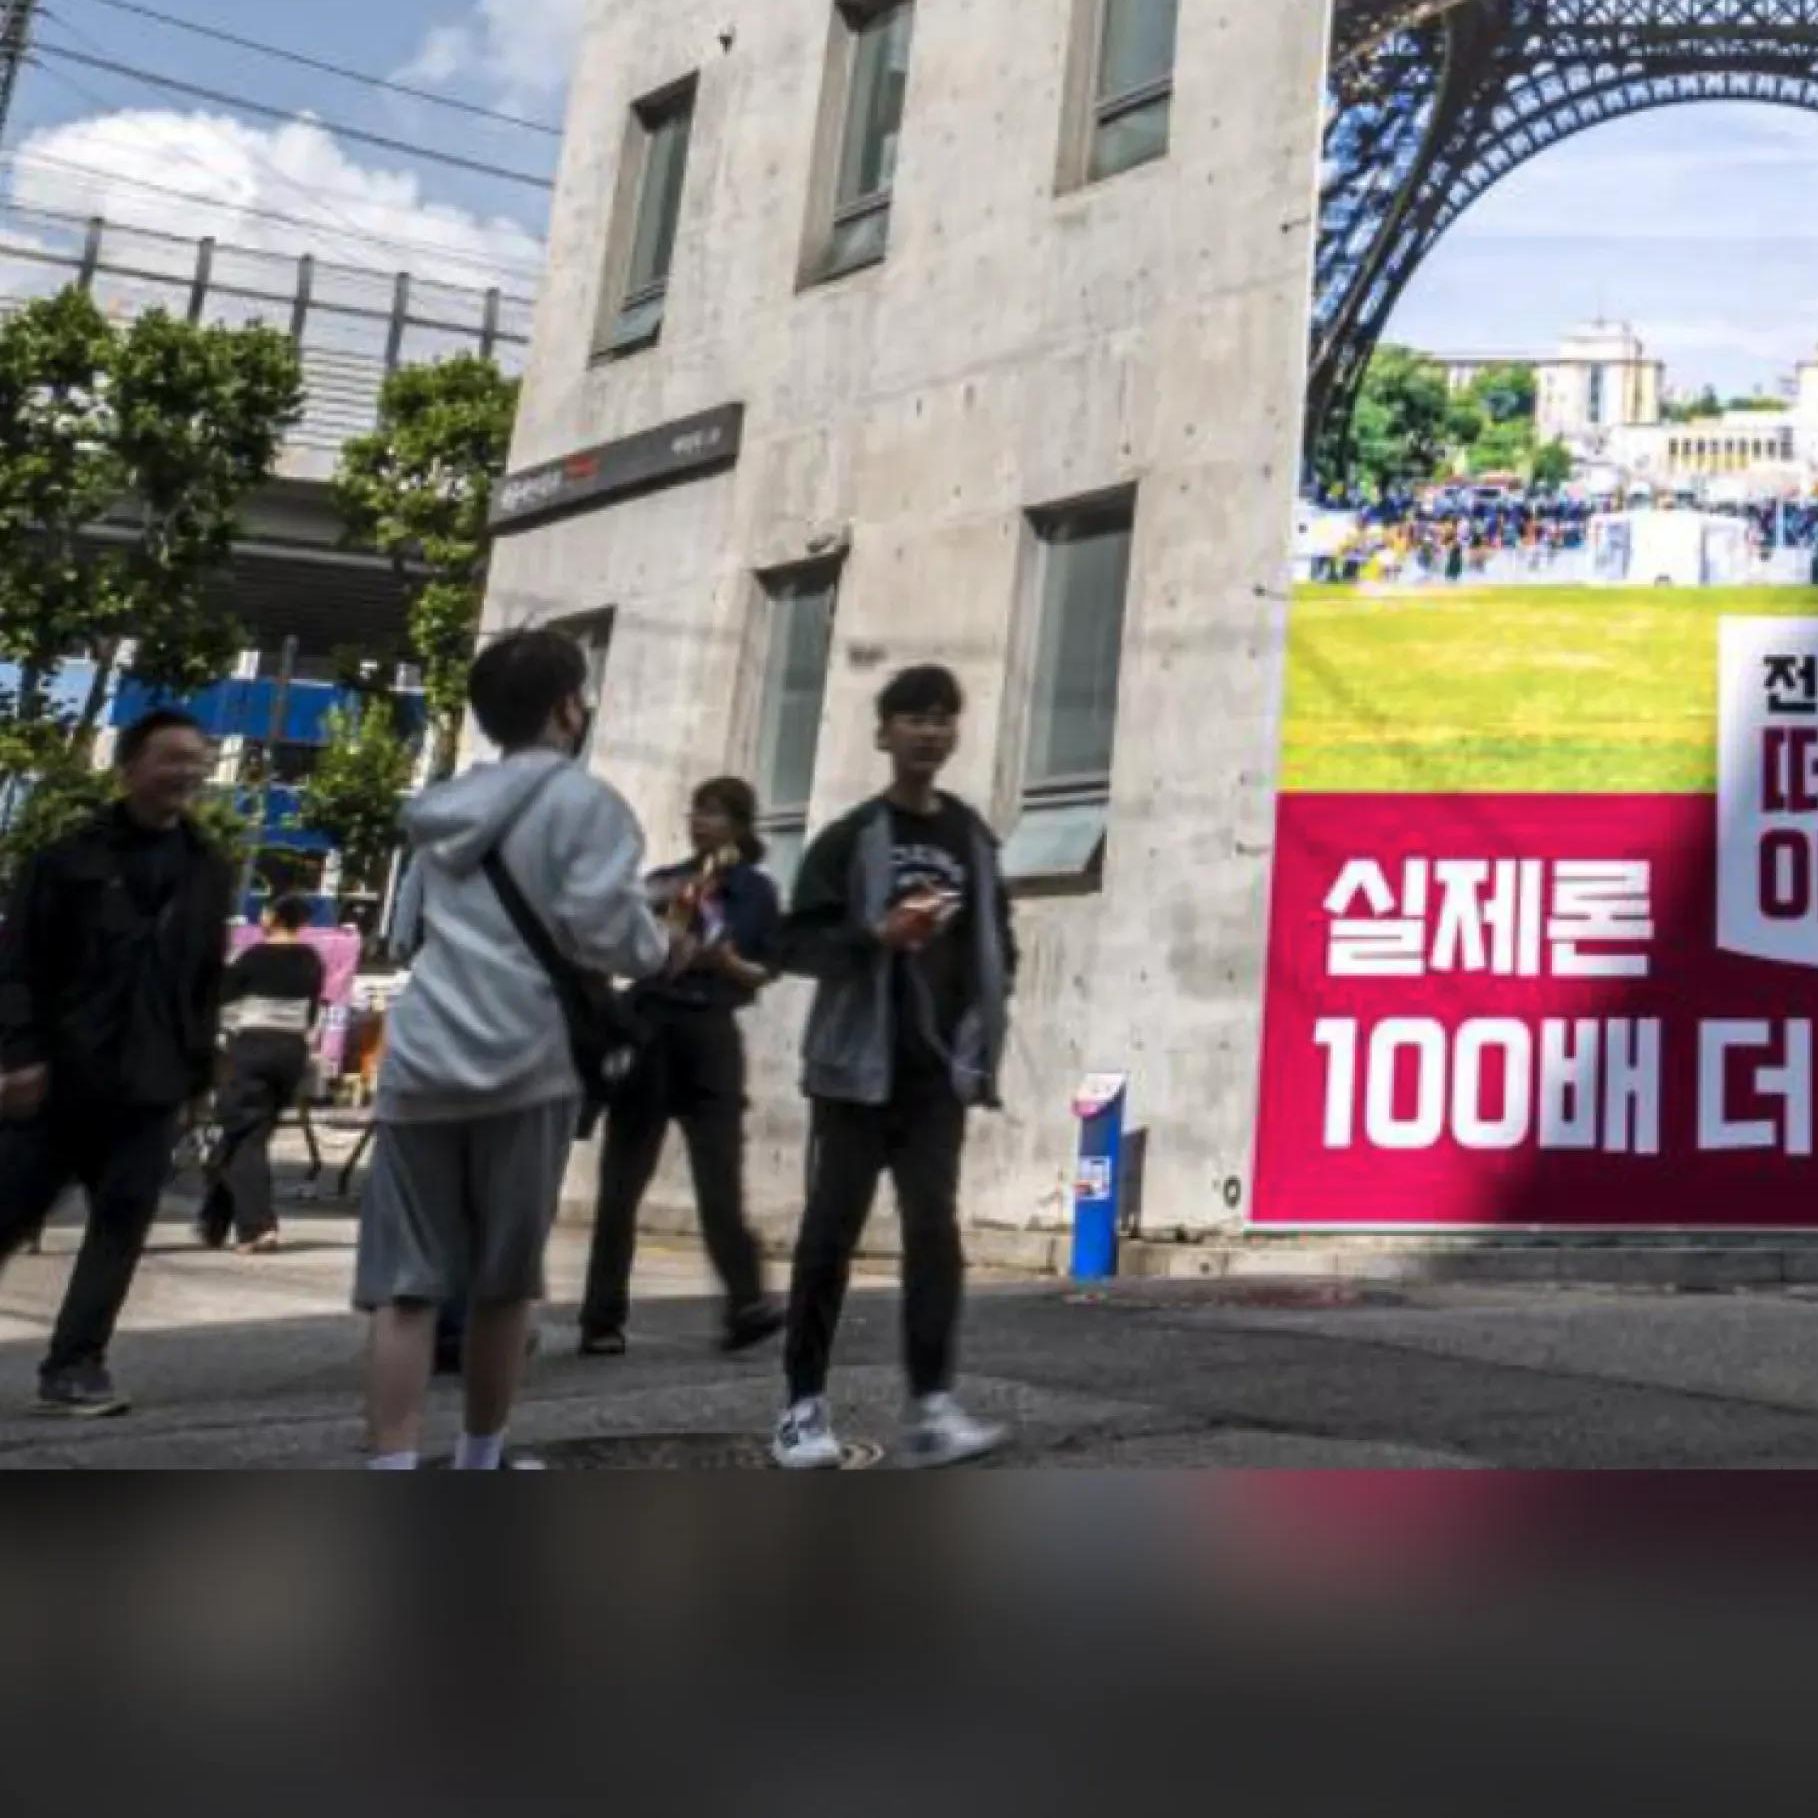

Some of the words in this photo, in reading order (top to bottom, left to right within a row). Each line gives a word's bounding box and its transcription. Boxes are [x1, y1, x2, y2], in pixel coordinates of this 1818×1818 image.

[1322, 857, 1656, 978] 실제론
[1313, 1015, 1660, 1155] 100배
[1697, 1016, 1812, 1157] 더
